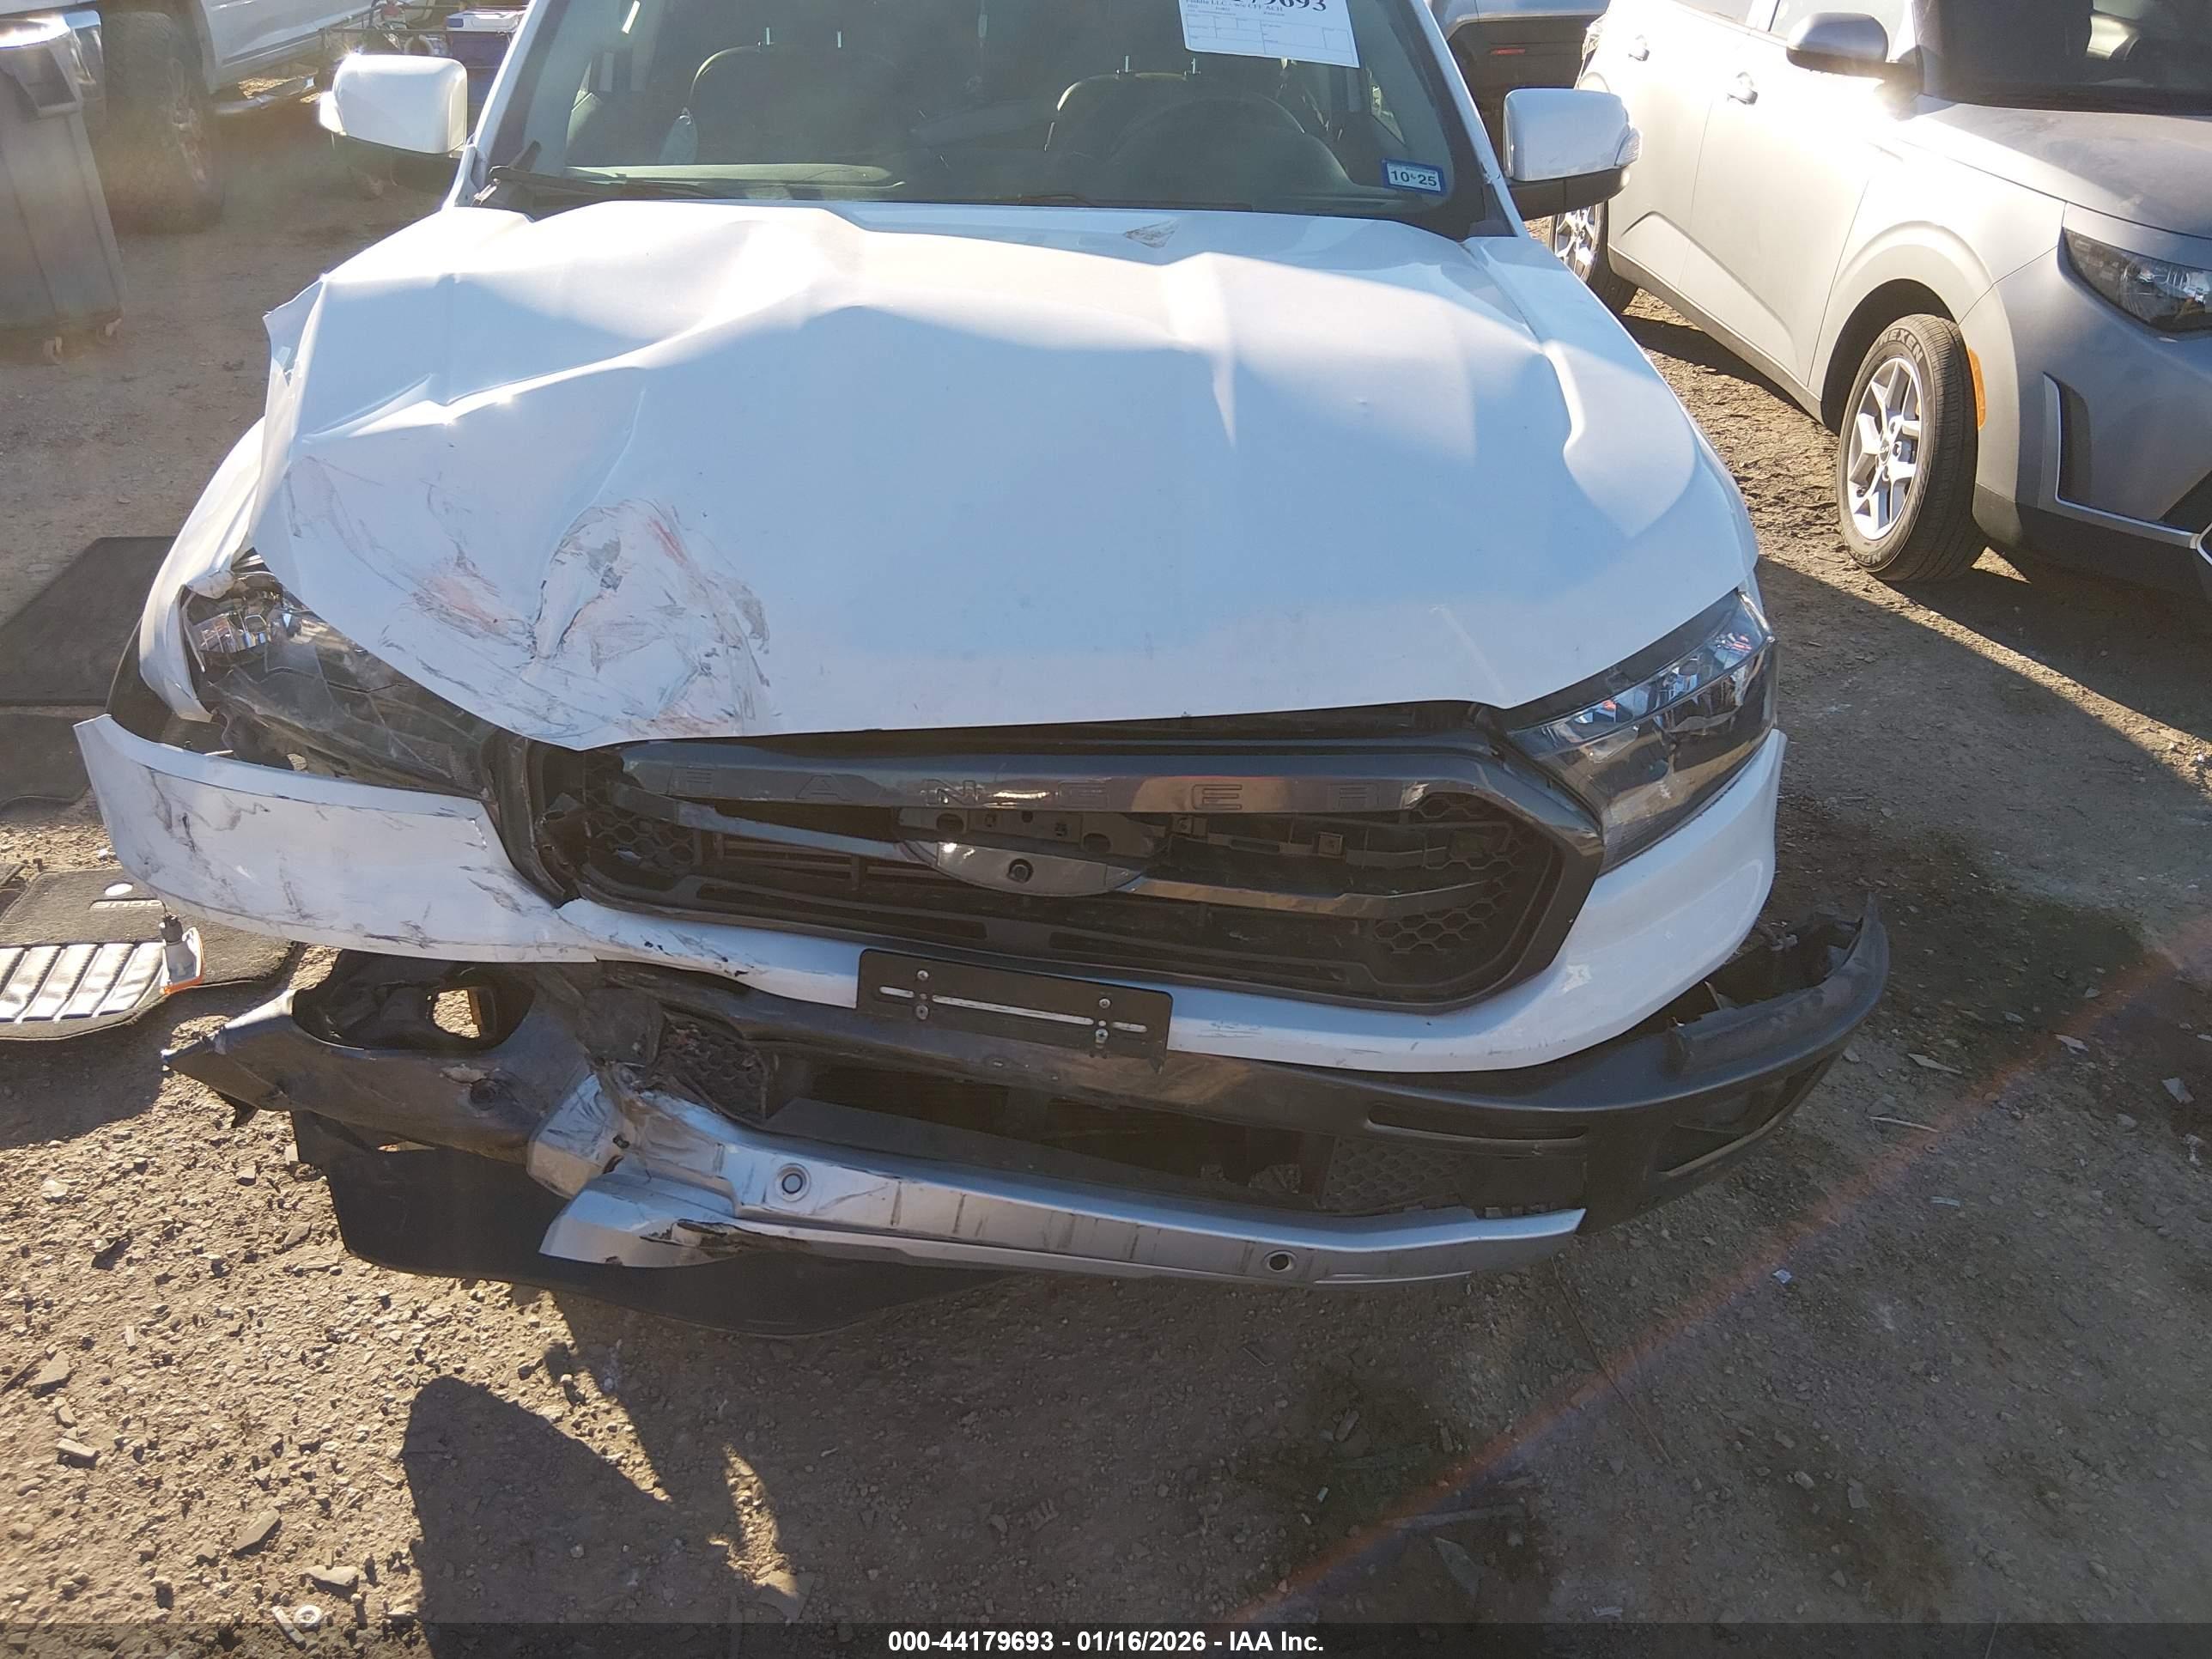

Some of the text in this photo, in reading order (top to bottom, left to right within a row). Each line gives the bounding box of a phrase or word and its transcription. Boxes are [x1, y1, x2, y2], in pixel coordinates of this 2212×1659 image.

[1390, 170, 1410, 183] 10
[1418, 173, 1437, 186] 25
[1878, 328, 1923, 364] NEXEN
[92, 898, 162, 908] OGUE
